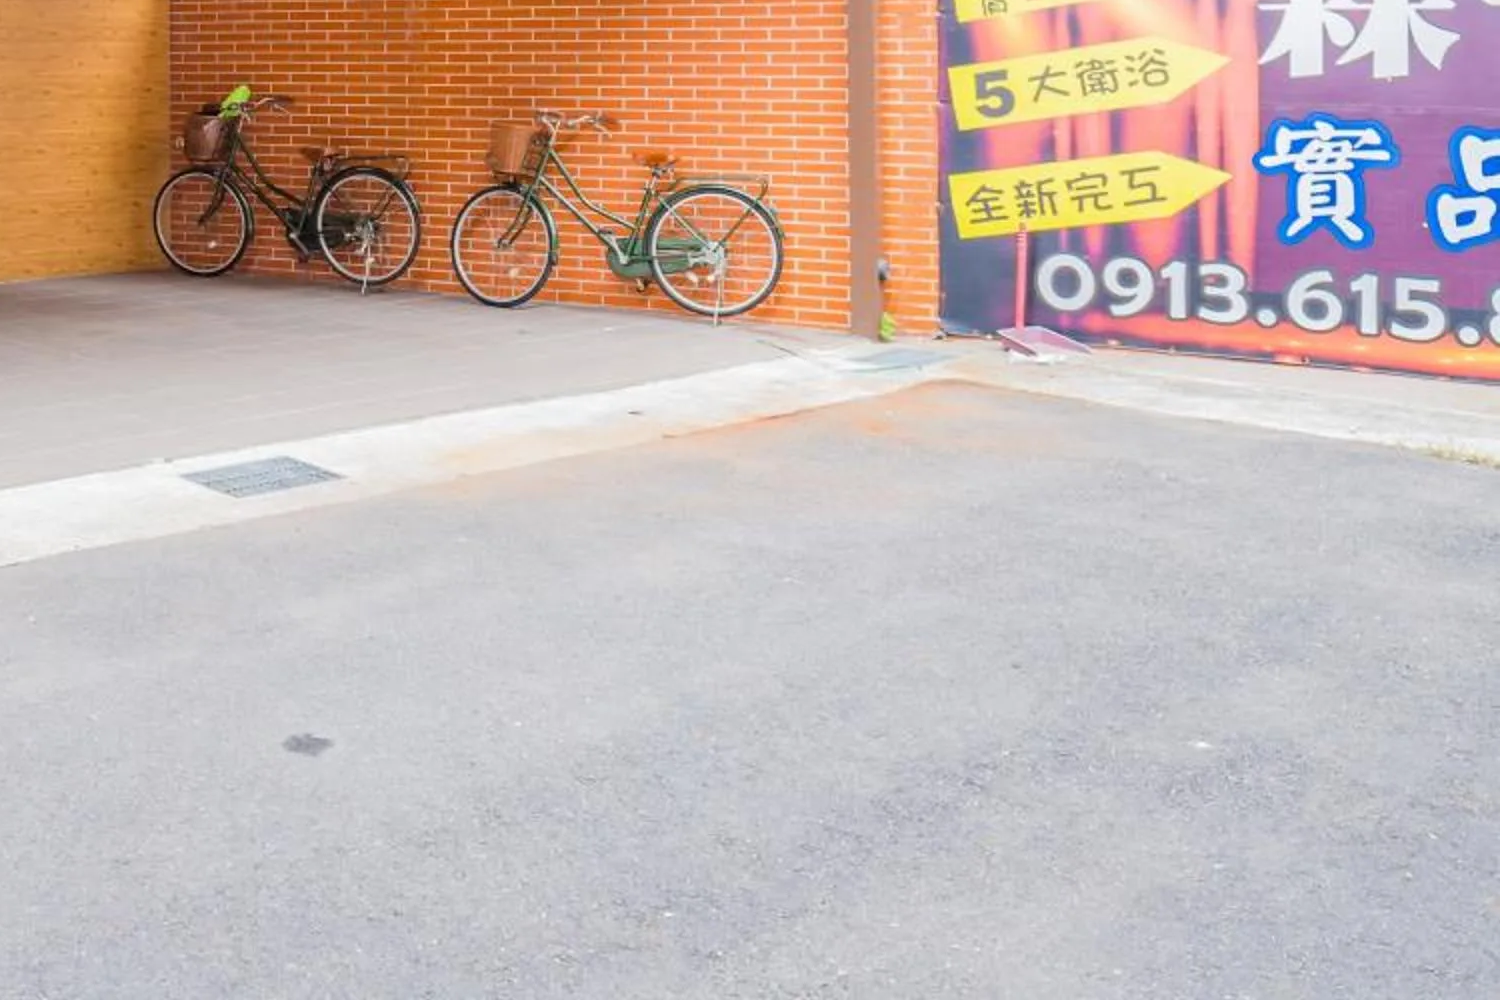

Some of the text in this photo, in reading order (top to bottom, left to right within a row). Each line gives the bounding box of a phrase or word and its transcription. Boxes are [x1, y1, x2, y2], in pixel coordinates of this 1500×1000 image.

[964, 165, 1169, 225] 全新完工
[1035, 253, 1500, 345] 0913.615.
